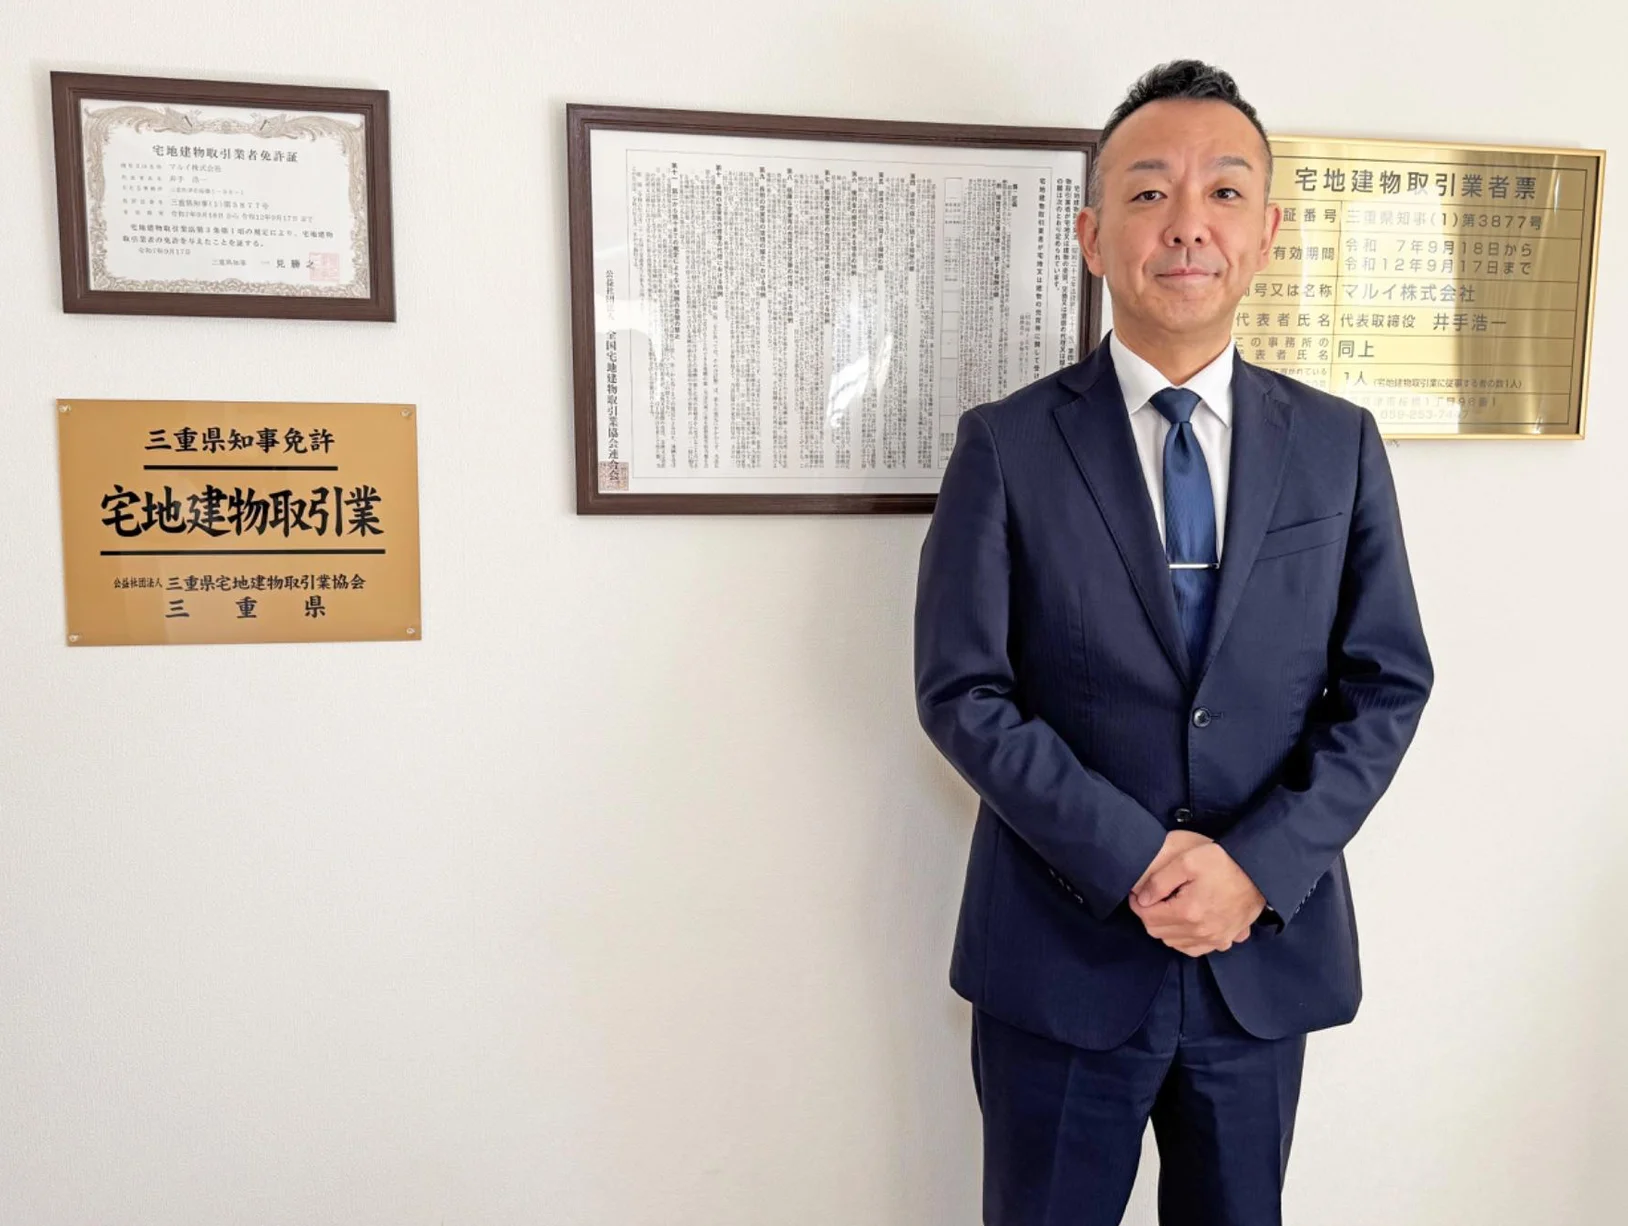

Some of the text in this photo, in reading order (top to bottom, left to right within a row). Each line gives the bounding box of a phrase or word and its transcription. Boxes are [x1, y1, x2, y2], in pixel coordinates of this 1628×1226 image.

[153, 145, 299, 163] 宅地建物取引業者免許証
[1295, 167, 1537, 200] 宅地建物取引業者票
[1273, 246, 1335, 261] 有効期間
[1341, 283, 1476, 303] マルイ株式会社
[1236, 313, 1507, 332] 代表者氏名 代表取締役 井手浩一
[1338, 340, 1375, 358] 同上
[144, 427, 336, 454] 三重県知事免許
[101, 485, 385, 538] 宅地建物取引業
[113, 574, 366, 590] 公益社団法人 三重県宅地建物取引業協会
[165, 596, 327, 619] 三重県
